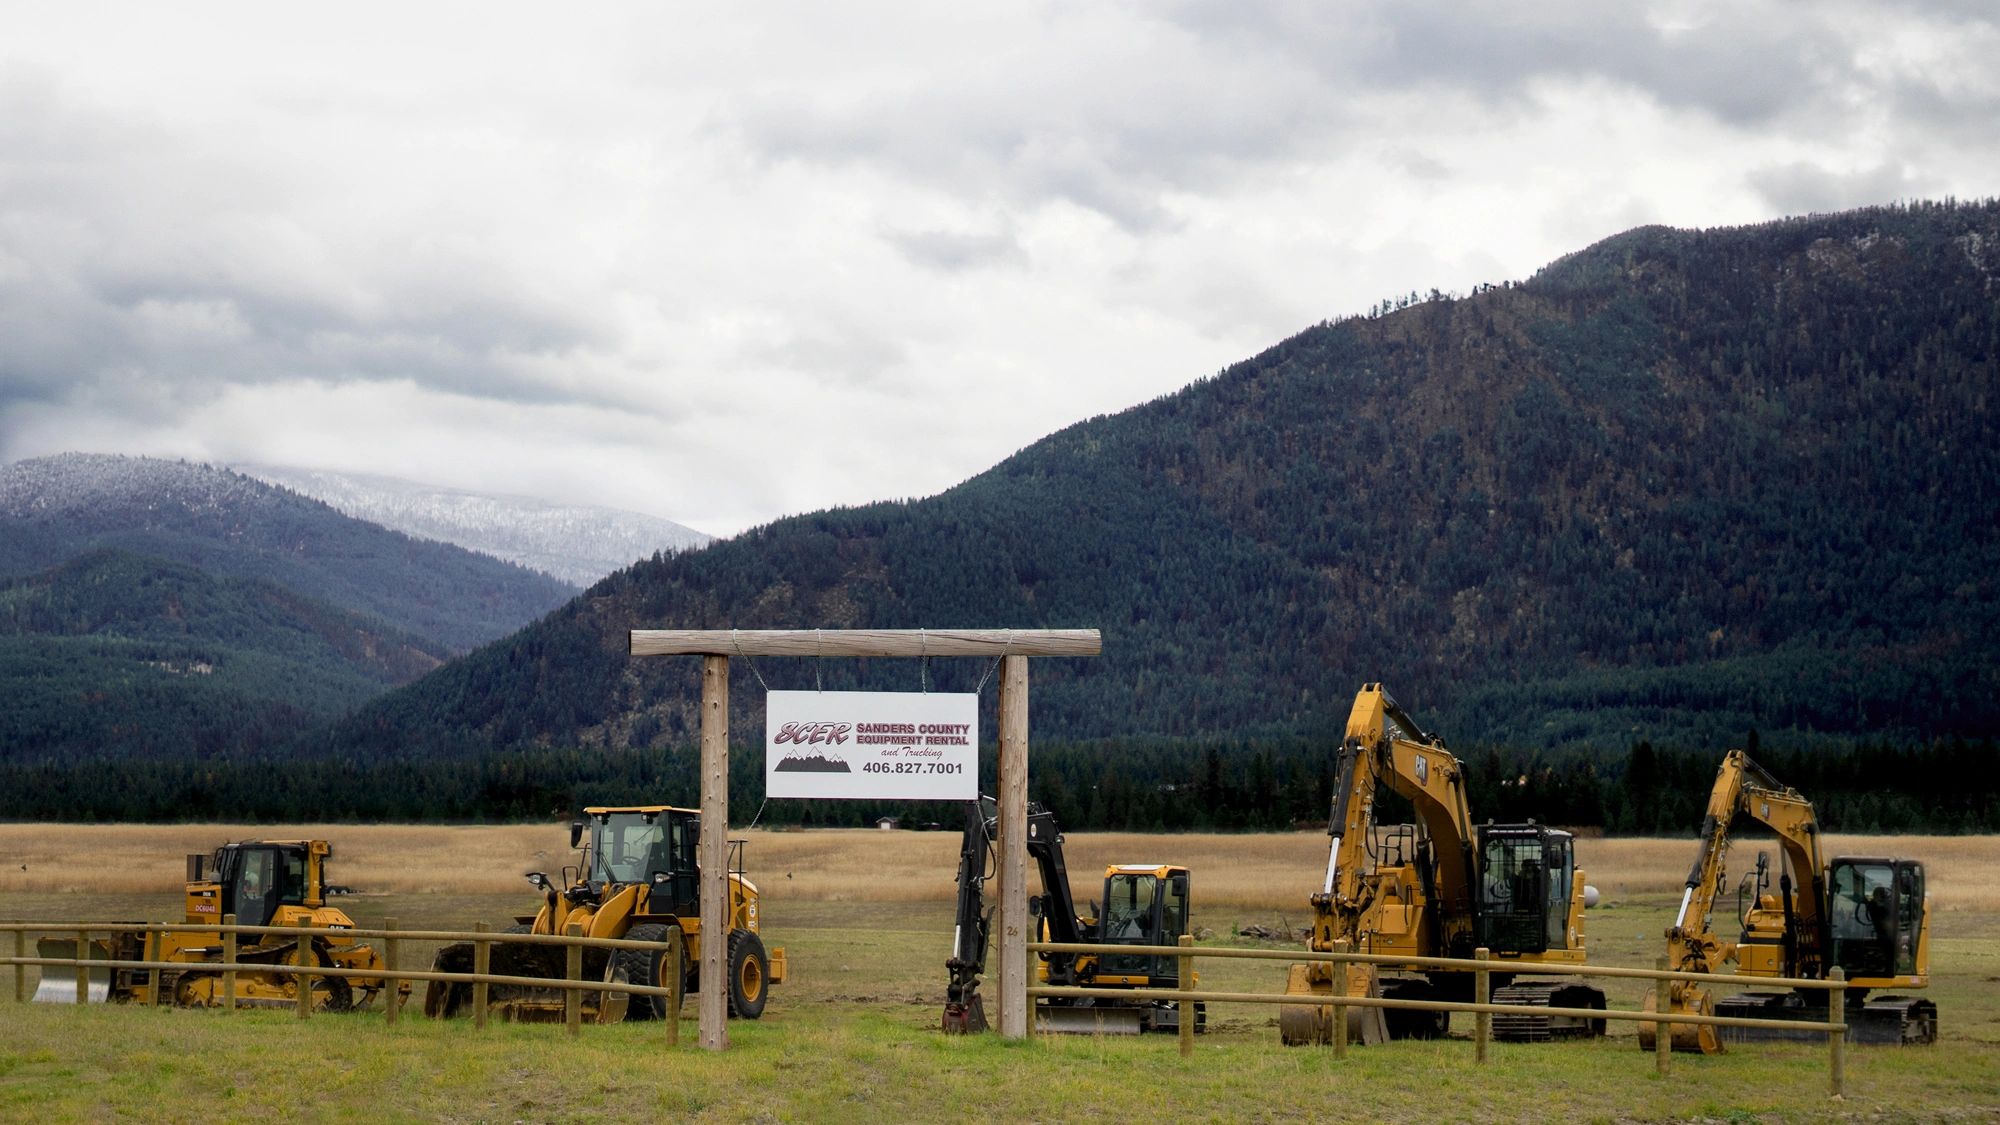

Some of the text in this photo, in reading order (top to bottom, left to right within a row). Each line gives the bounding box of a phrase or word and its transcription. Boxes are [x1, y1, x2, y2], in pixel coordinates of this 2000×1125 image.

[774, 721, 852, 745] SCER
[856, 723, 970, 735] SANDERS COUNTY
[856, 735, 969, 746] EQUIPMENT RENTAL
[881, 746, 943, 760] and Trucking
[863, 762, 963, 774] 406.827.7001
[1415, 754, 1427, 780] CAT
